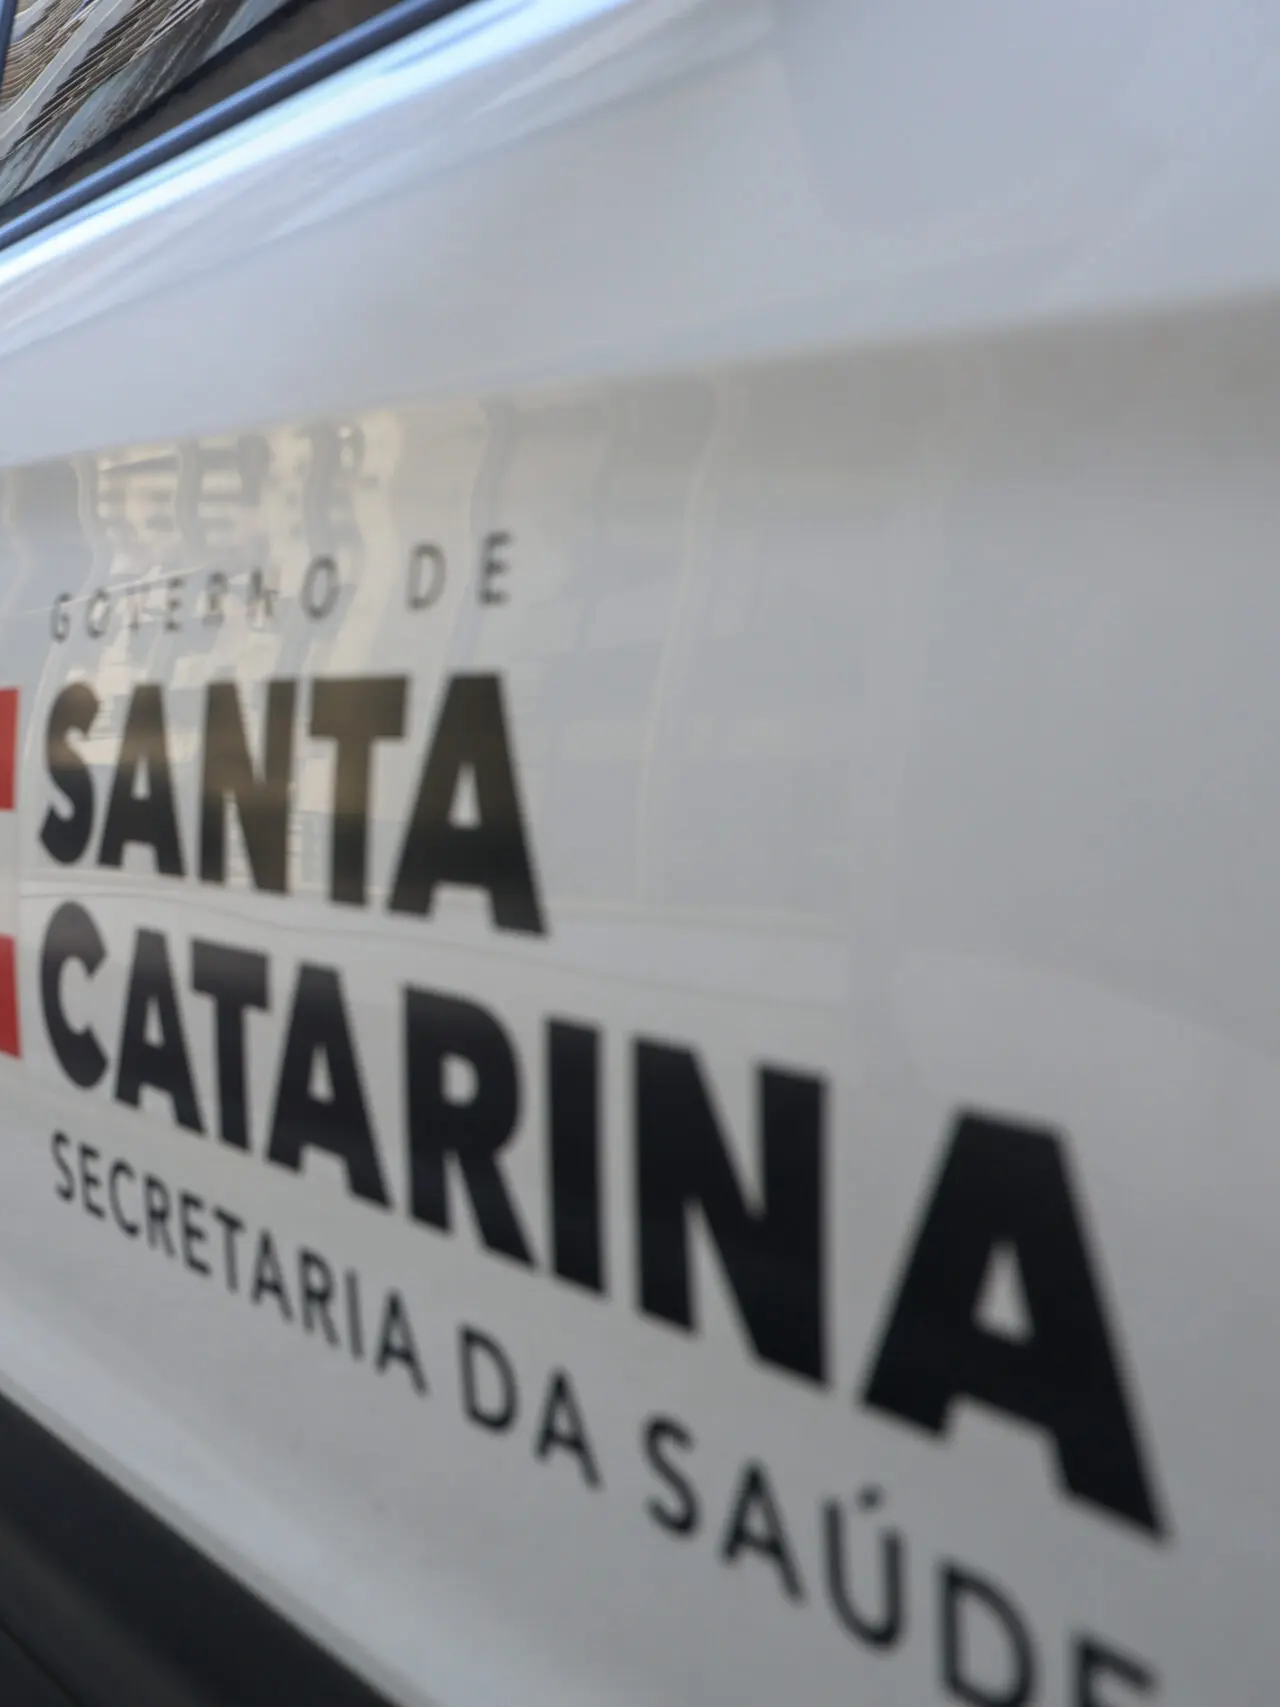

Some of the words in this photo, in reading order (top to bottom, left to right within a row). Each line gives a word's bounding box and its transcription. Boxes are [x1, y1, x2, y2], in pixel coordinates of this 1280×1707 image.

[49, 555, 340, 642] GOVERNO
[405, 530, 511, 613] DE
[38, 670, 549, 940] SANTA
[40, 902, 1171, 1543] CATARINA
[51, 1132, 428, 1396] SECRETARIA
[458, 1324, 603, 1490] DA
